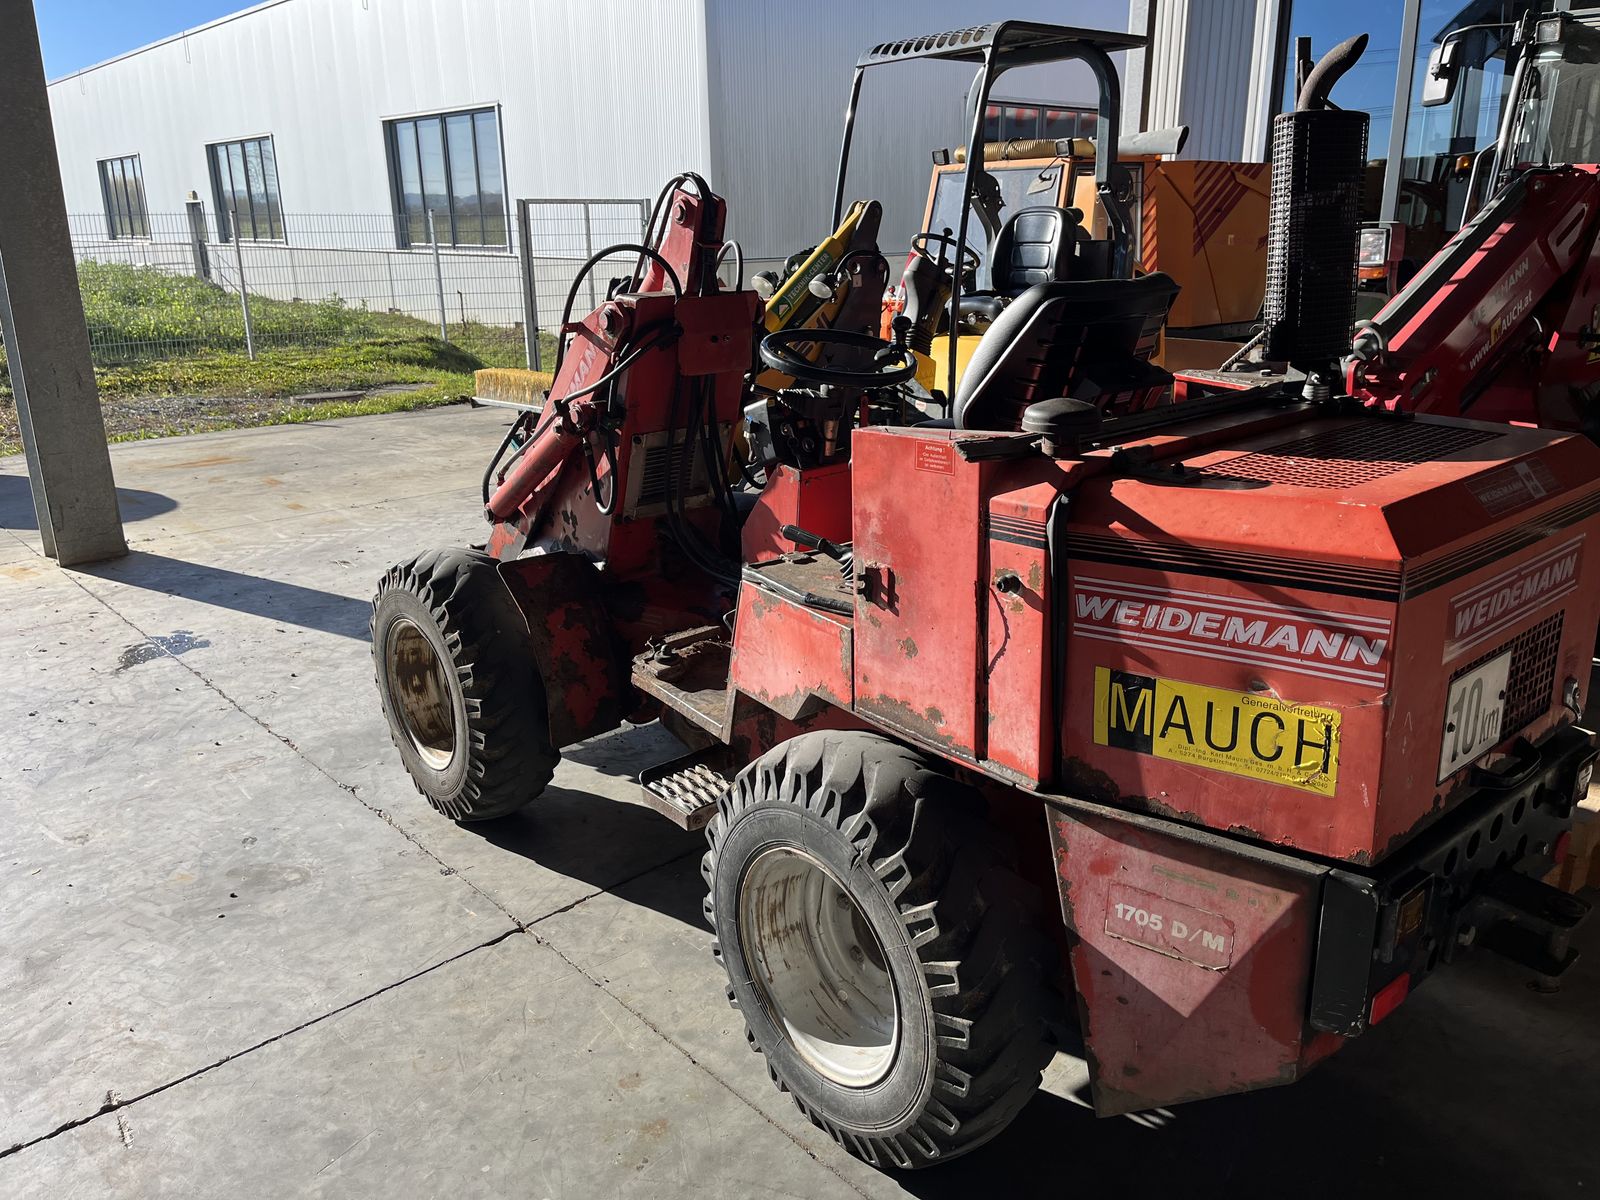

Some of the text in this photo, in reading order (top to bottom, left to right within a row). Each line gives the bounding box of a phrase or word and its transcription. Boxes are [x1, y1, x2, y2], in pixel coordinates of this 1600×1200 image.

[1075, 593, 1387, 666] WEIDEMANN
[1455, 552, 1577, 638] WEIDEMANN
[1109, 682, 1332, 775] MAUCH
[1114, 902, 1225, 953] 1705 D/M
